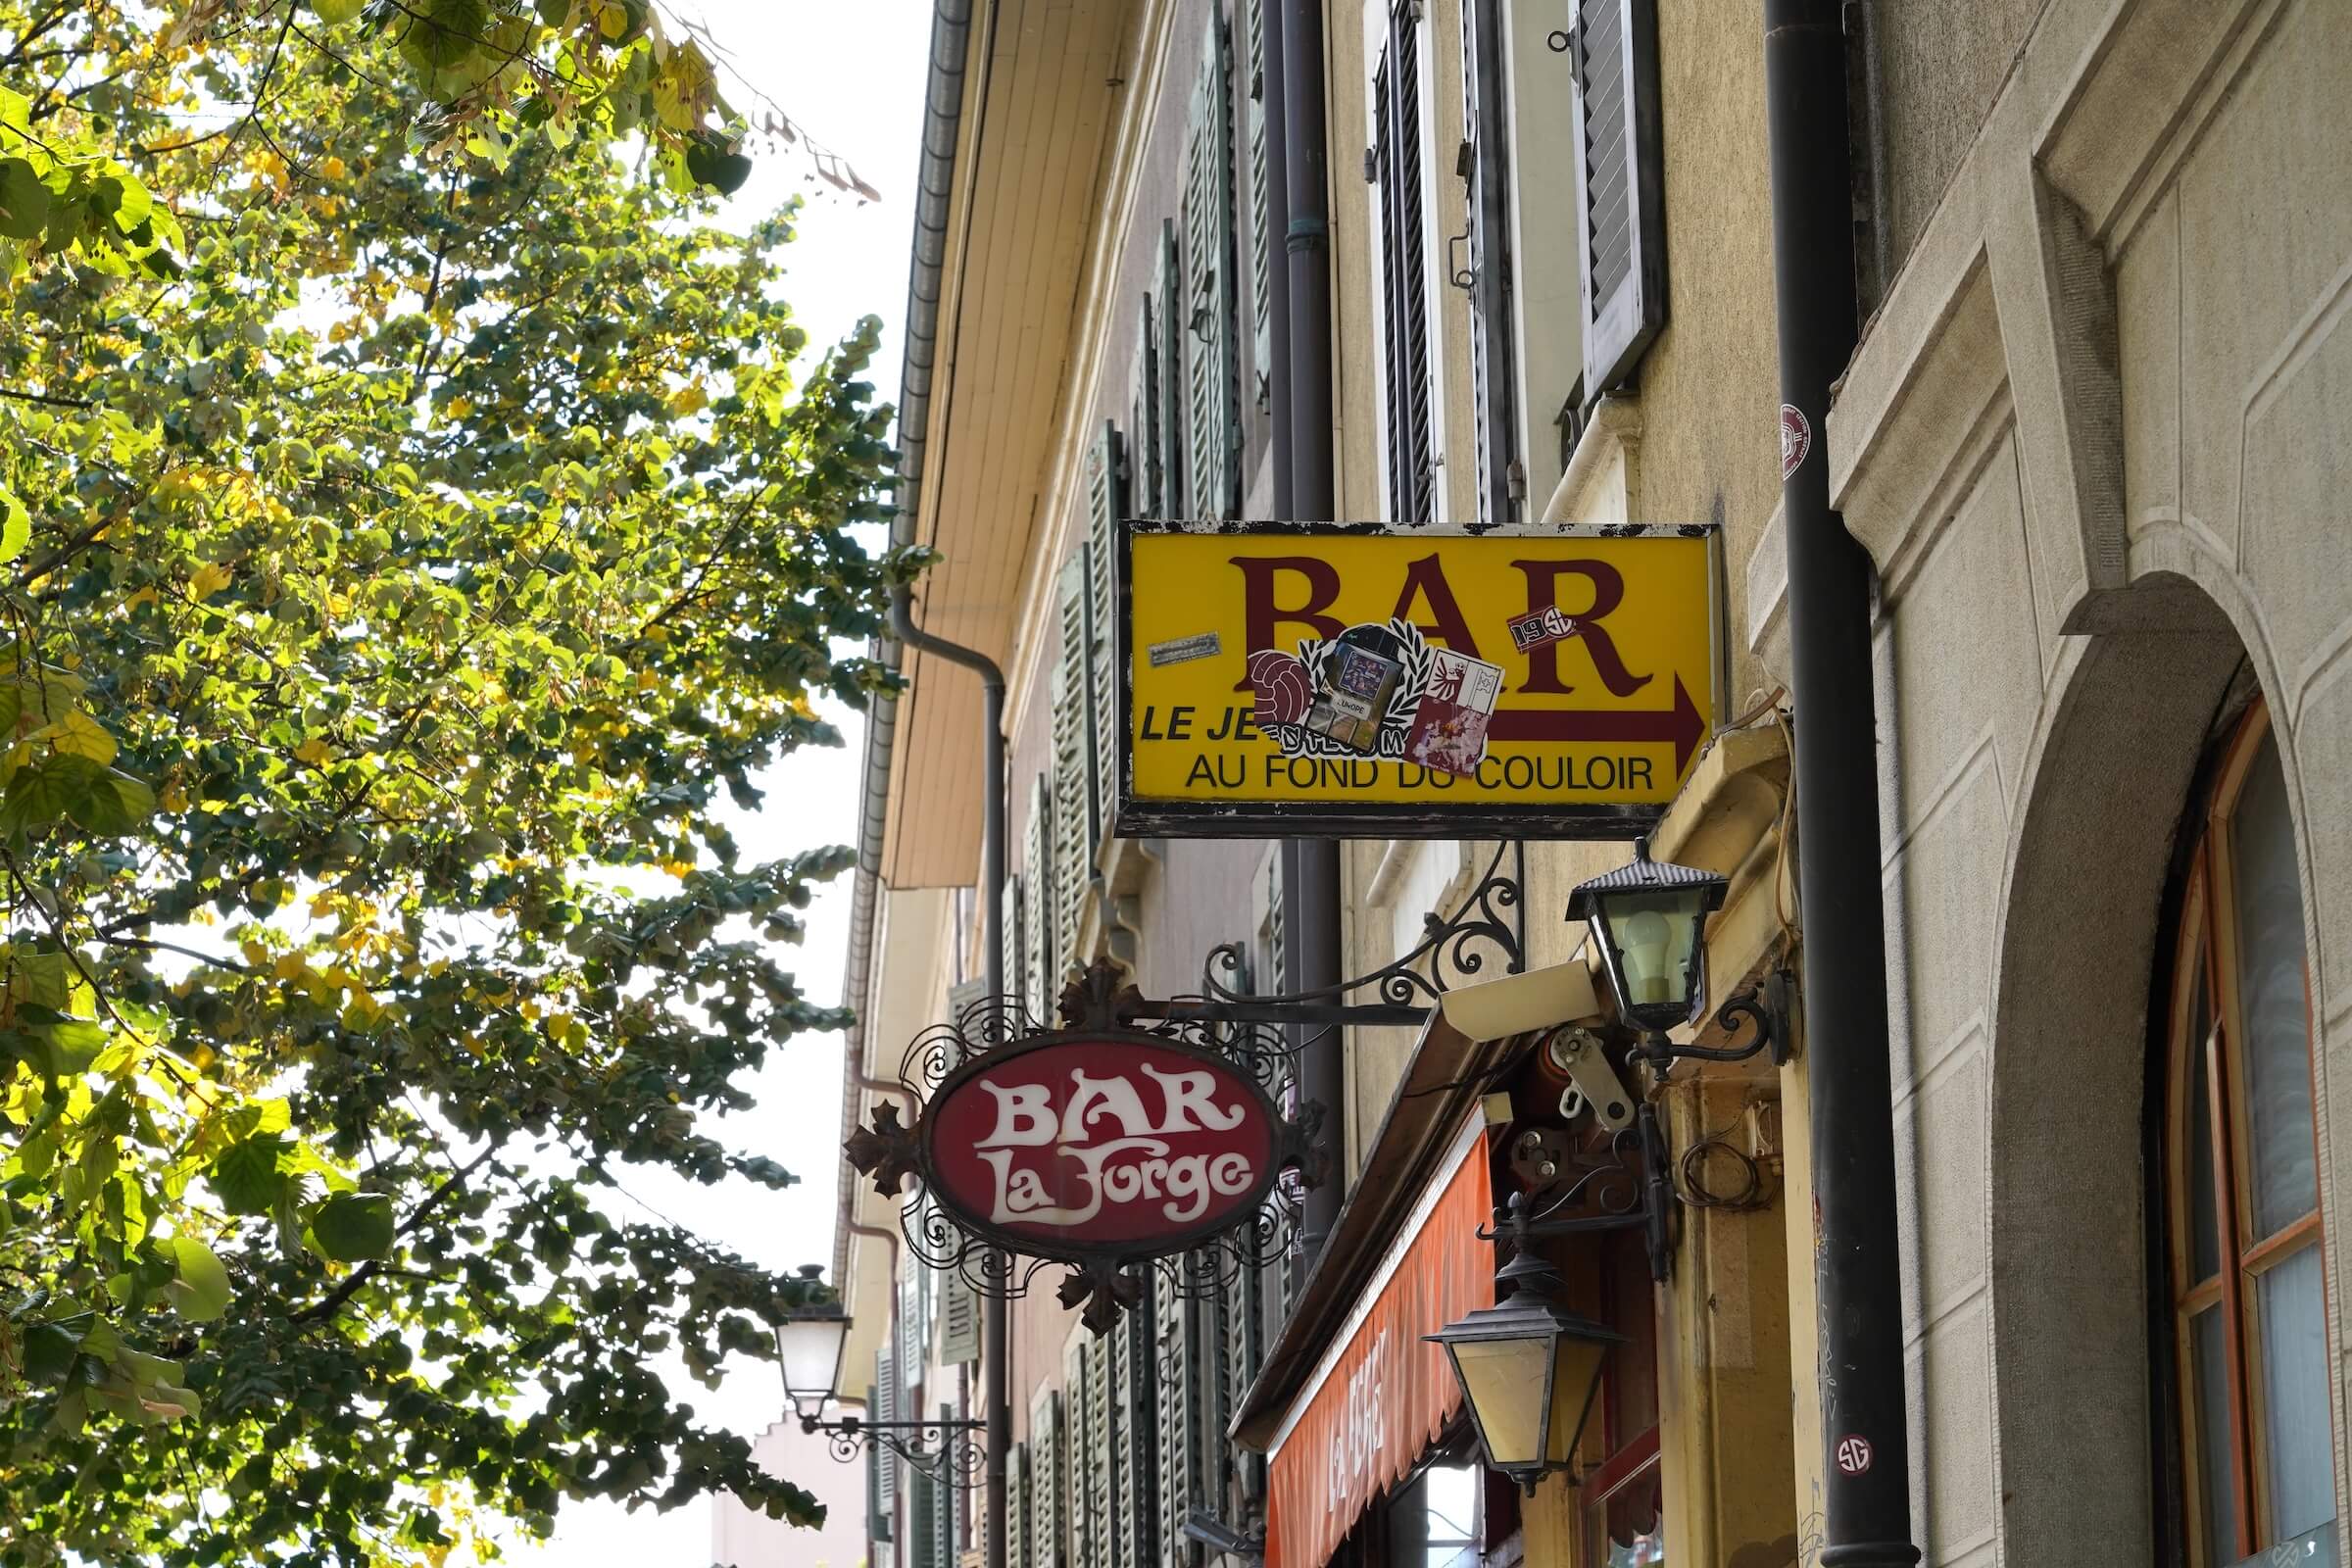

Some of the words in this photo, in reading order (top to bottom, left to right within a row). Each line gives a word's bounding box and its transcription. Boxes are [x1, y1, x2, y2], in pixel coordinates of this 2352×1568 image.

[1229, 552, 1654, 697] BAR
[1510, 617, 1547, 647] 19
[1141, 707, 1196, 740] LE
[1206, 707, 1258, 740] JE
[1185, 754, 1246, 788] AU
[1266, 754, 1378, 789] FOND
[1399, 761, 1456, 789] DU
[1475, 756, 1654, 790] COULOIR
[973, 1063, 1246, 1149] BAR
[1057, 1137, 1254, 1225] Forge
